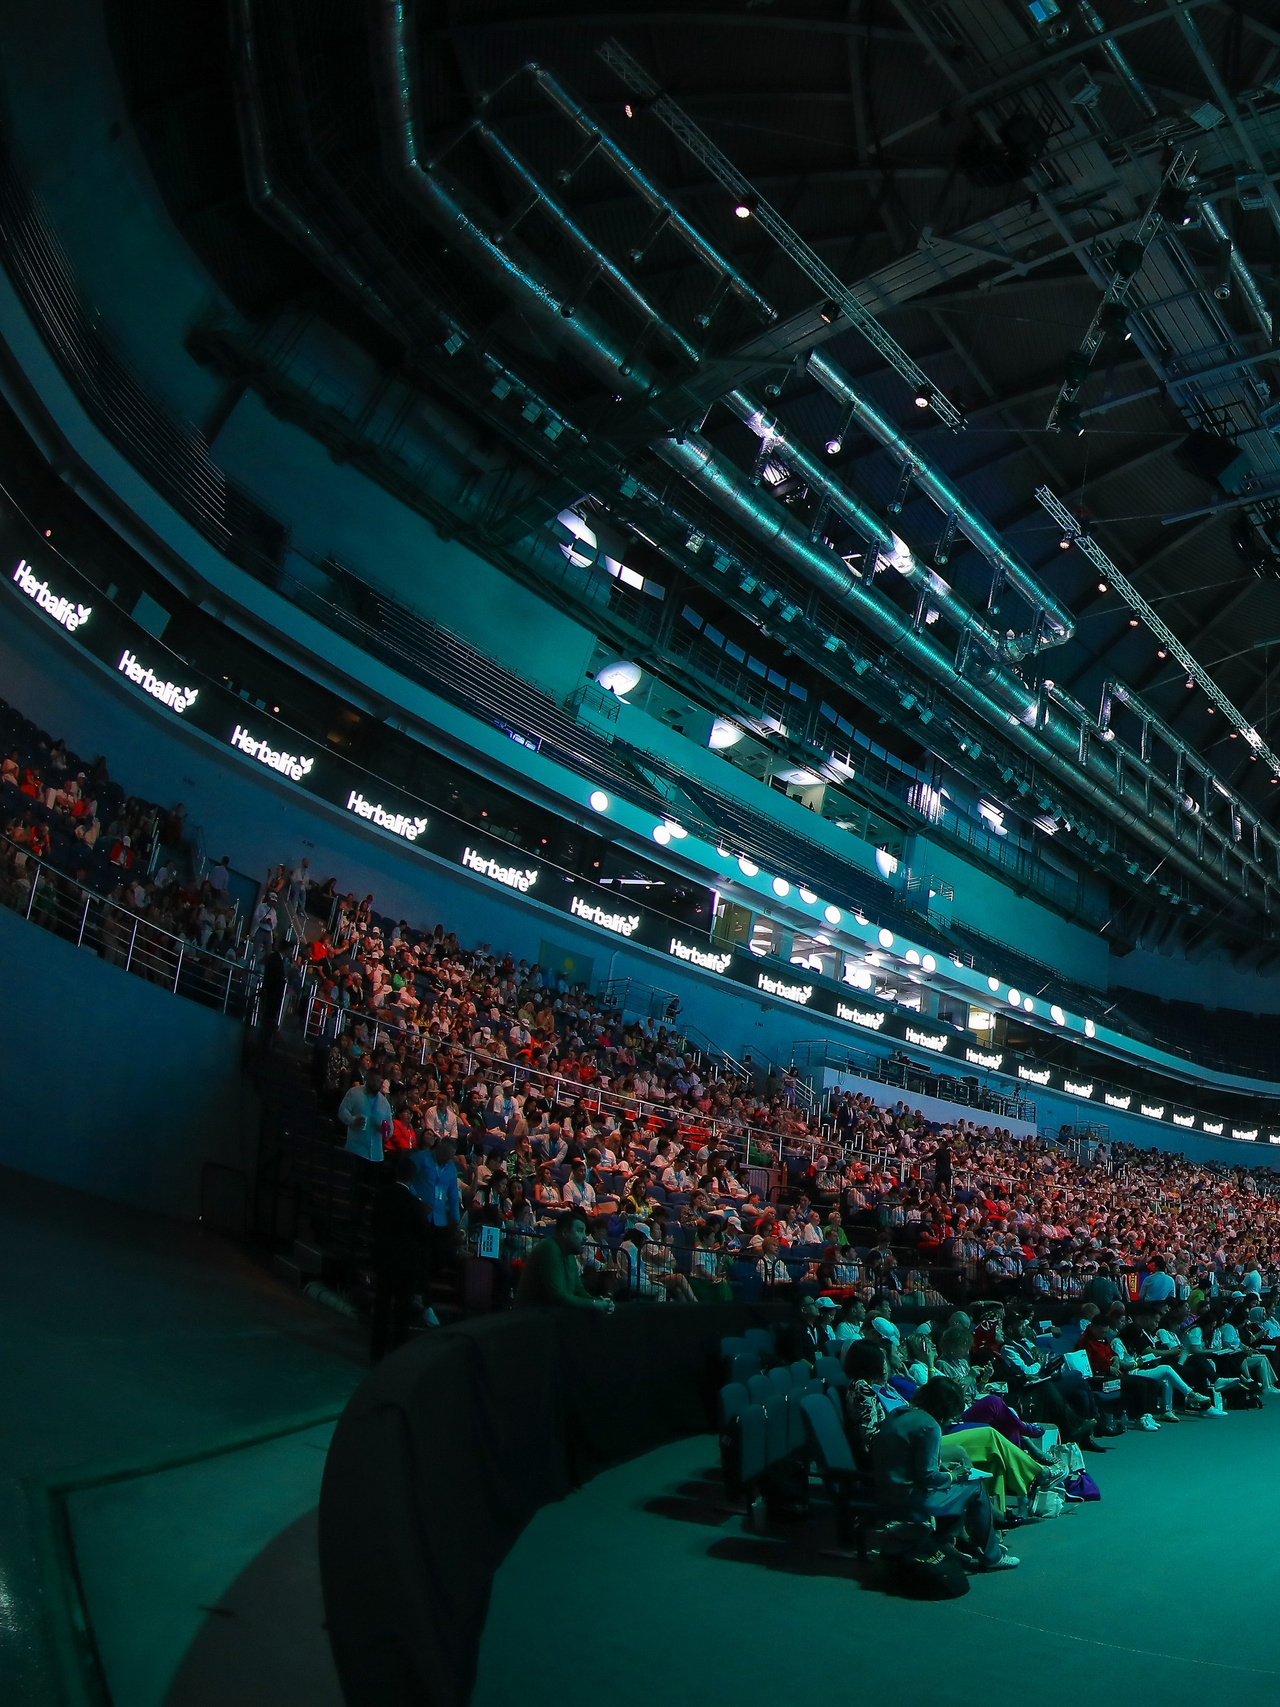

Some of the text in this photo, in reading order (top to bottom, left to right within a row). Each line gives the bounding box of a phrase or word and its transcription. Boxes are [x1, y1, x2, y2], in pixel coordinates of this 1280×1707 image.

[13, 559, 80, 632] Herbalife
[118, 649, 187, 713] Herbalife
[230, 724, 304, 781] Herbalife
[346, 790, 418, 841] Herbalife
[461, 846, 529, 893] Herbalife
[570, 896, 633, 937] Herbalife
[669, 937, 726, 974] Herbalife
[757, 973, 808, 1005] Herbalife
[836, 1002, 881, 1031] Herbalife
